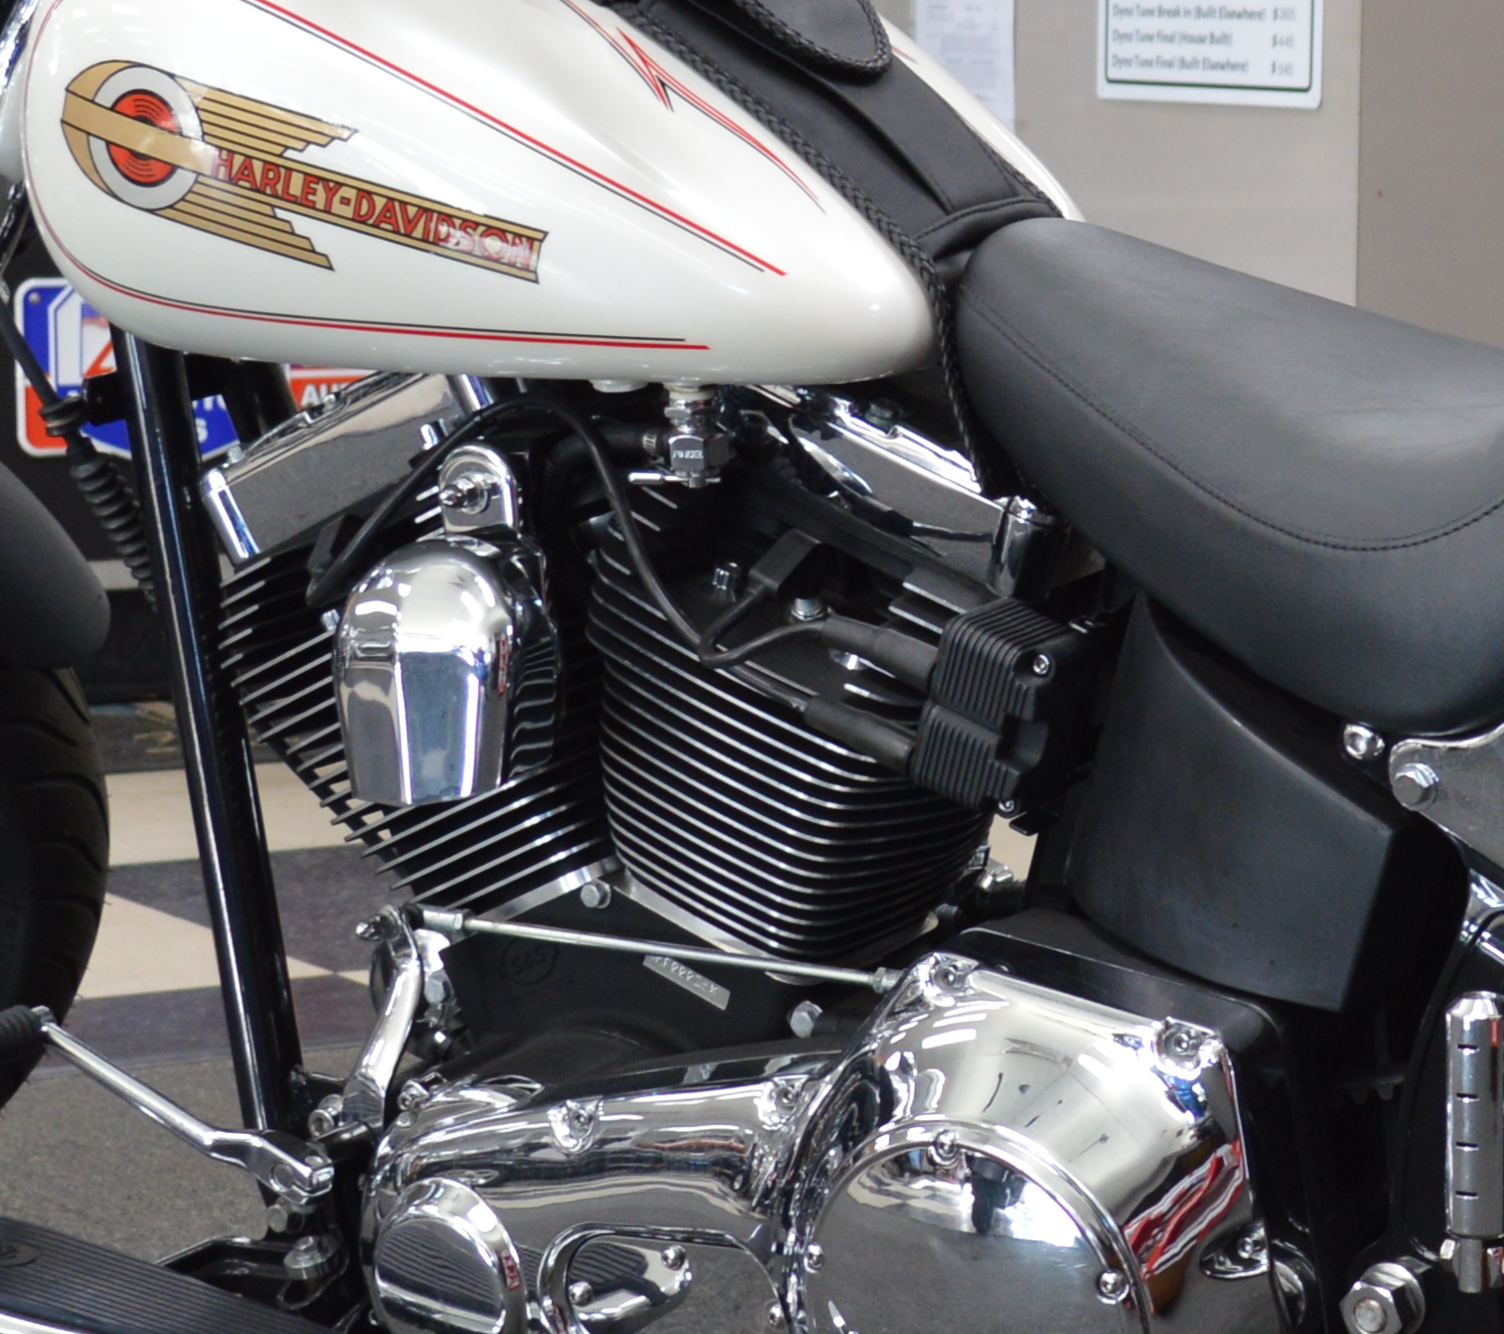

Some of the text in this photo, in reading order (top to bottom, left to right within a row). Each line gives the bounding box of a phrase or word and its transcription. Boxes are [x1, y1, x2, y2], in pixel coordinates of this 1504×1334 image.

[1135, 4, 1155, 18] Tune
[1157, 4, 1182, 19] Break
[1135, 29, 1155, 43] Tune
[1134, 54, 1154, 68] Tune
[211, 148, 535, 272] HARLEY-DAVIDSON
